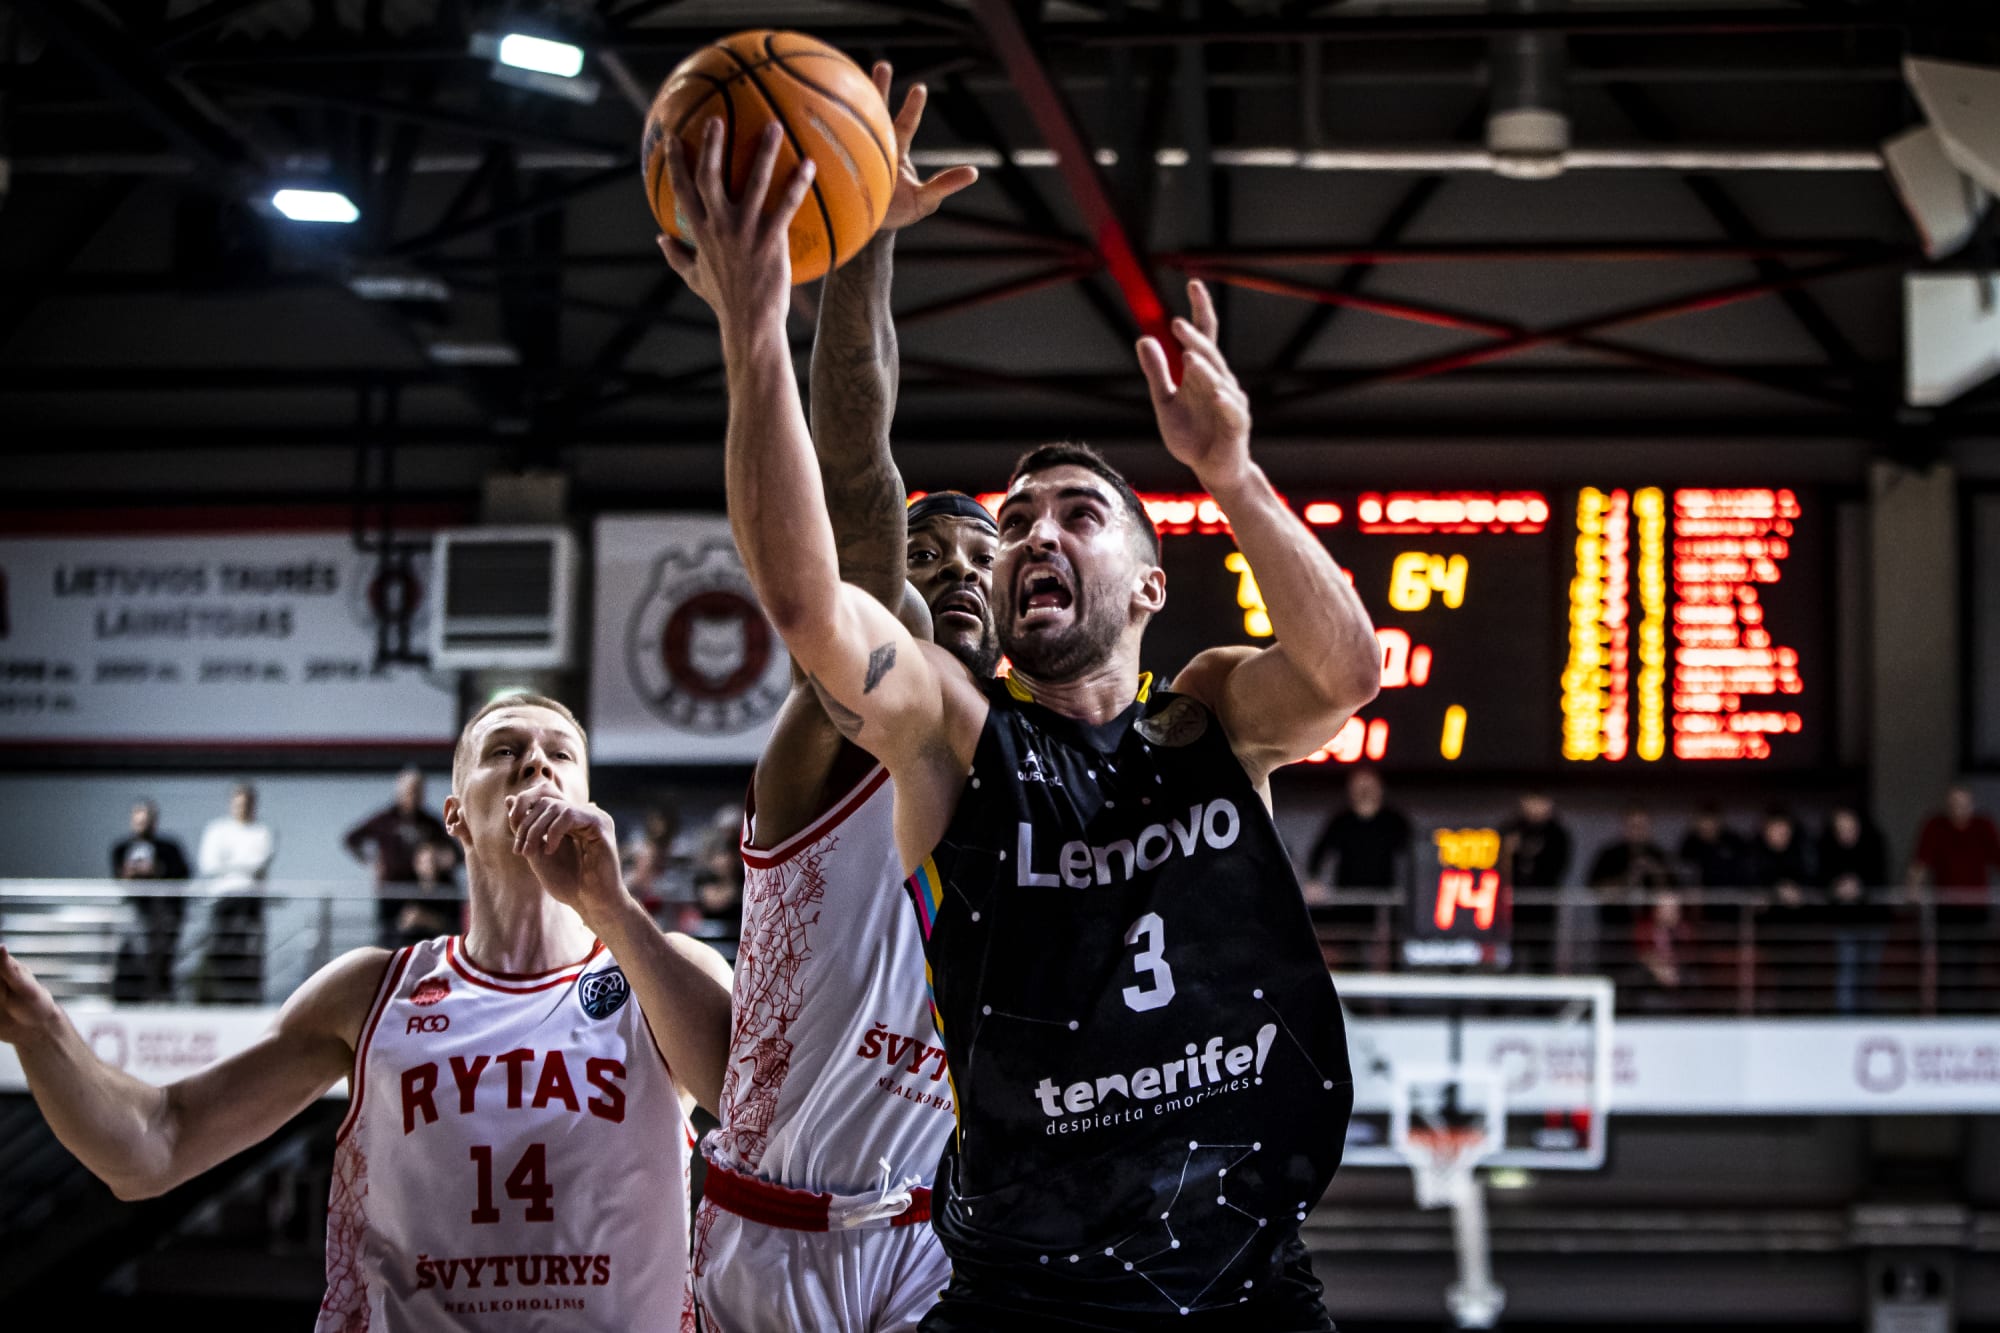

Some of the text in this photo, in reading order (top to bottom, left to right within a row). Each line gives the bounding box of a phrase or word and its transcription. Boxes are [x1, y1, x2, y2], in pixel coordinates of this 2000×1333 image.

[1389, 551, 1468, 611] 64
[1017, 798, 1240, 889] Lenovo
[1434, 869, 1500, 931] 14
[1122, 912, 1176, 1012] 3
[401, 1048, 626, 1136] RYTAS
[876, 1077, 957, 1115] NEALKOHO
[1046, 1107, 1143, 1135] despierta
[469, 1143, 554, 1224] 14
[416, 1254, 611, 1290] ŠVYTURYS
